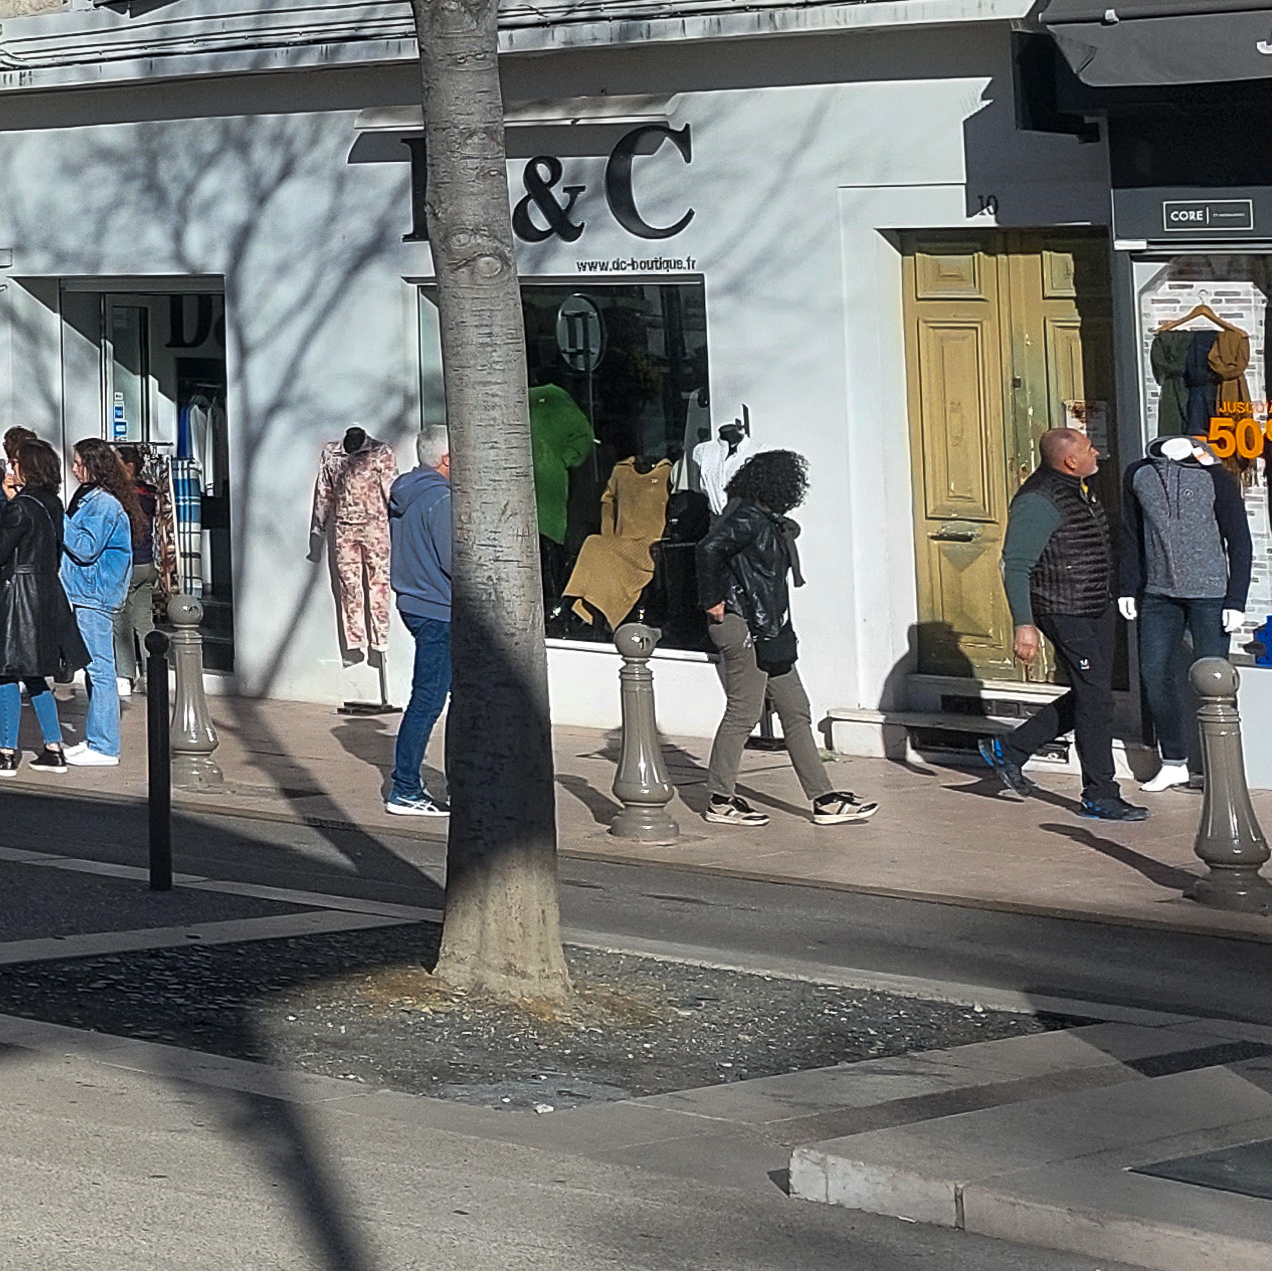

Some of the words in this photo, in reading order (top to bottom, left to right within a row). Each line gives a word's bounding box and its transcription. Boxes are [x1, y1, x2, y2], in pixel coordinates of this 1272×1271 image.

[512, 155, 587, 243] &
[606, 123, 697, 241] C
[1170, 210, 1204, 222] CORE
[575, 256, 697, 273] www.dc-boutique.fr
